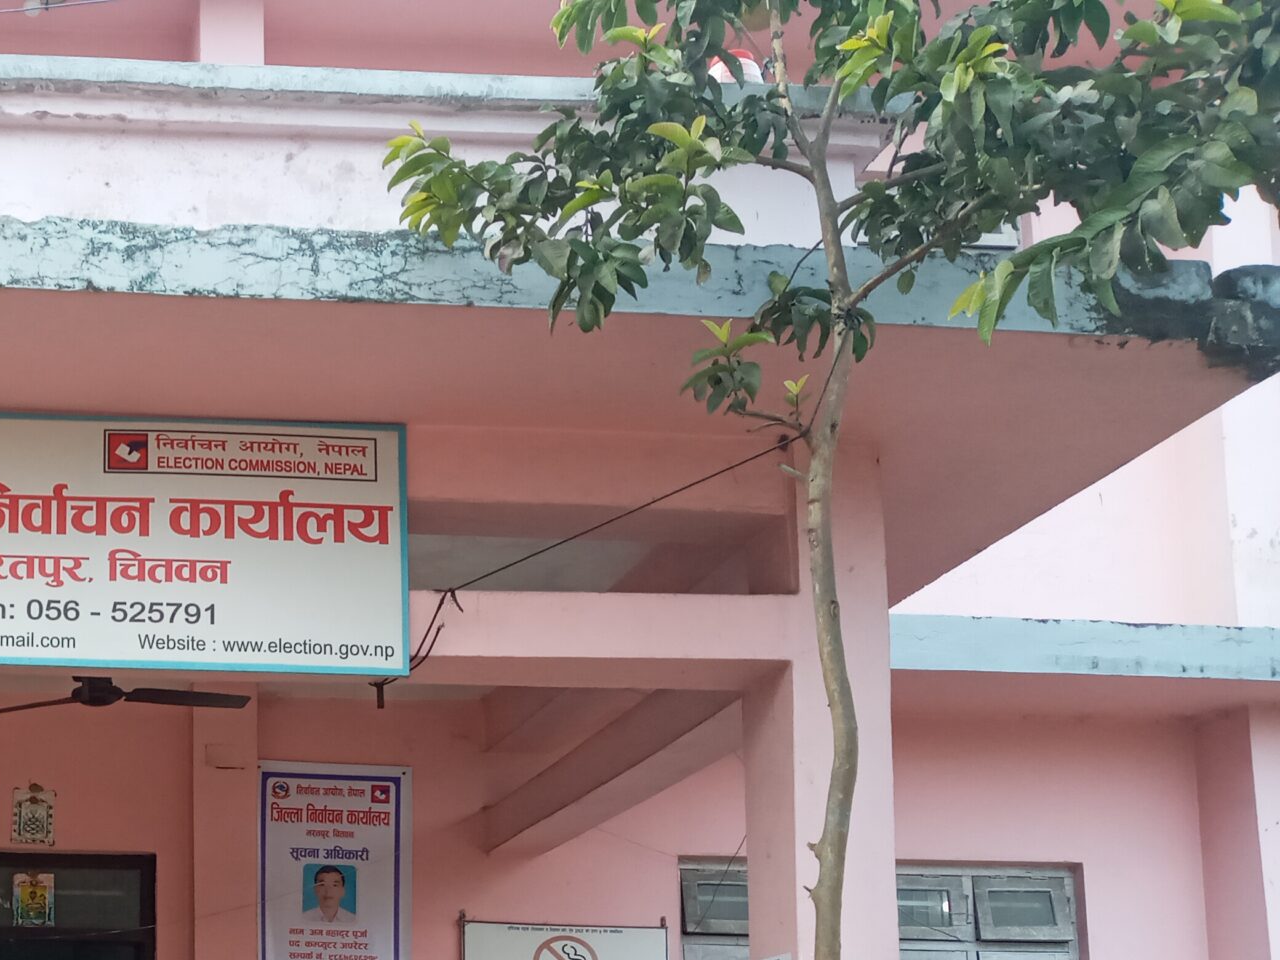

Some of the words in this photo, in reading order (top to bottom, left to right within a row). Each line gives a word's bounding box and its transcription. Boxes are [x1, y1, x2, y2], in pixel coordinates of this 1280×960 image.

[155, 434, 228, 453] निर्वाचन
[239, 438, 300, 458] आयोग,
[317, 440, 368, 458] नेपाल
[157, 456, 224, 472] ELECTION
[228, 458, 320, 476] COMMISSION,
[324, 462, 368, 476] NEPAL
[169, 489, 394, 545] कार्यालय
[107, 548, 232, 585] चितवन
[26, 599, 81, 622] 056
[110, 601, 216, 625] 525791
[138, 633, 207, 652] Website
[221, 638, 395, 661] www.election.gov.np
[271, 802, 303, 823] जिल्ला
[306, 803, 344, 825] निर्वाचन
[347, 807, 391, 827] कार्यालय
[323, 846, 370, 861] अधिकारी
